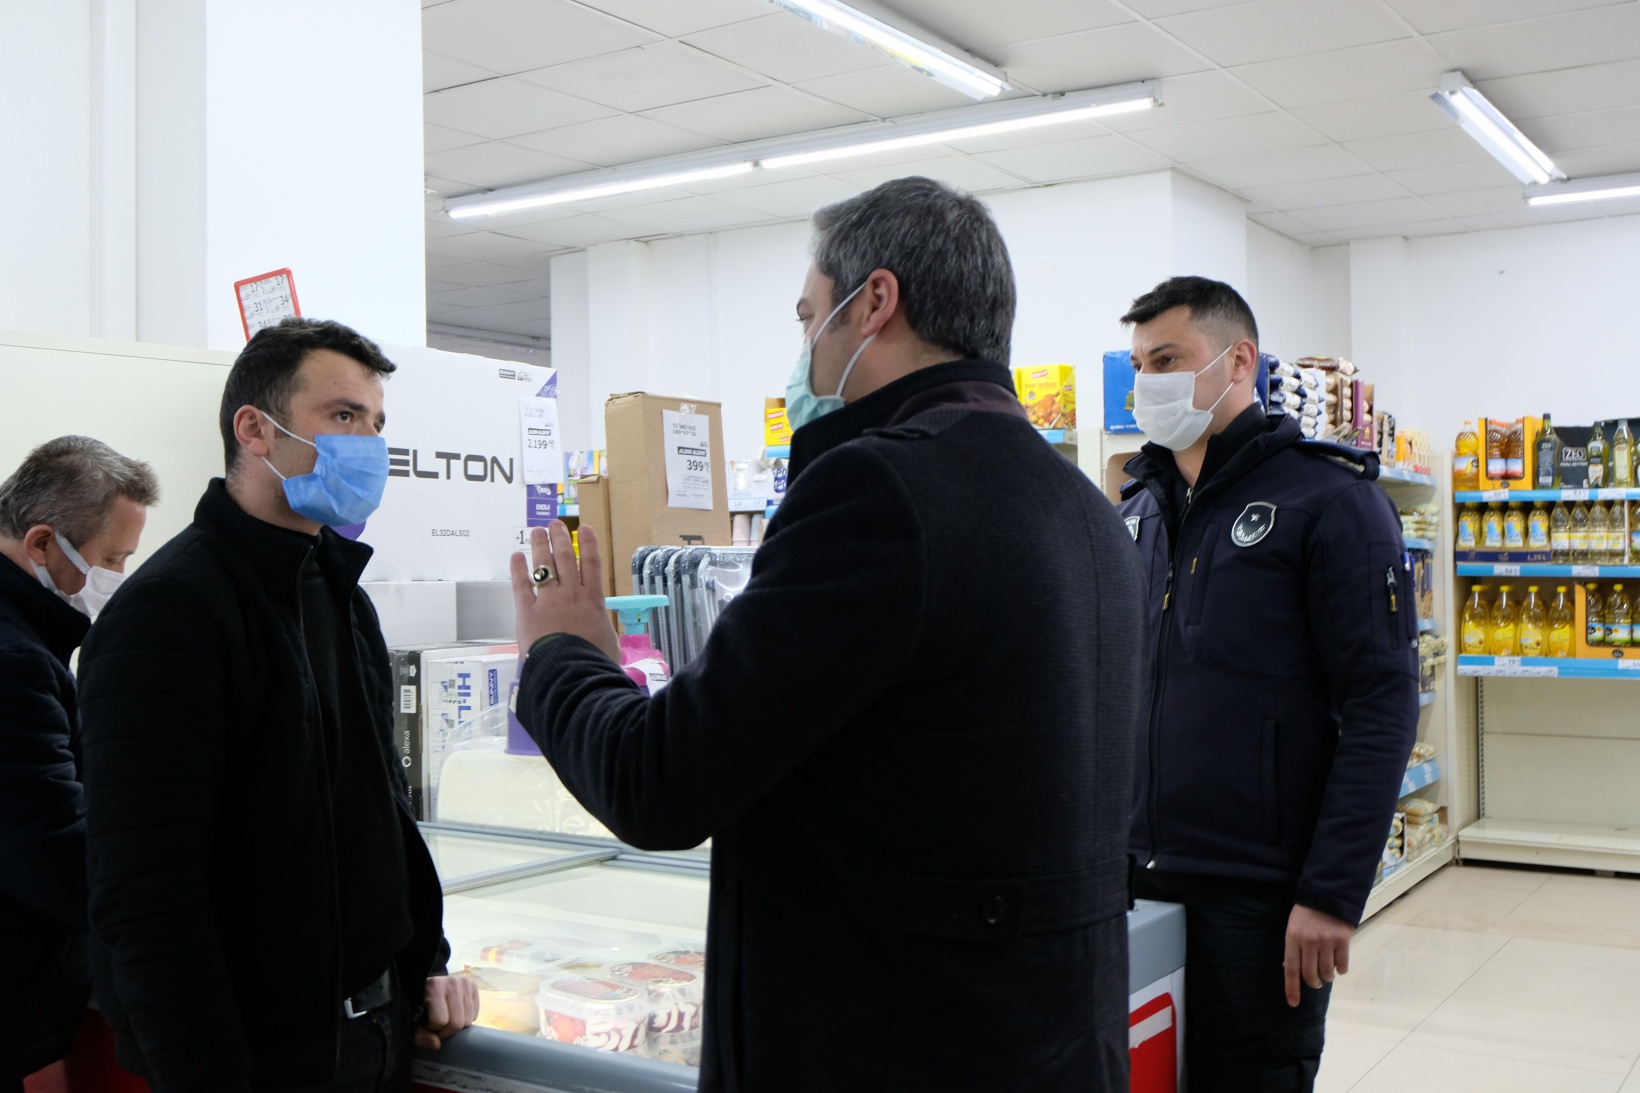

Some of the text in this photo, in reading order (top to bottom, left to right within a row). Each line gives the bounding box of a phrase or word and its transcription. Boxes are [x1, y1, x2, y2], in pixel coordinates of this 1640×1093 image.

[528, 438, 548, 450] 2.199
[1565, 448, 1584, 460] ZEO
[387, 446, 514, 484] ELTON
[686, 460, 704, 472] 399
[402, 730, 410, 754] alexa
